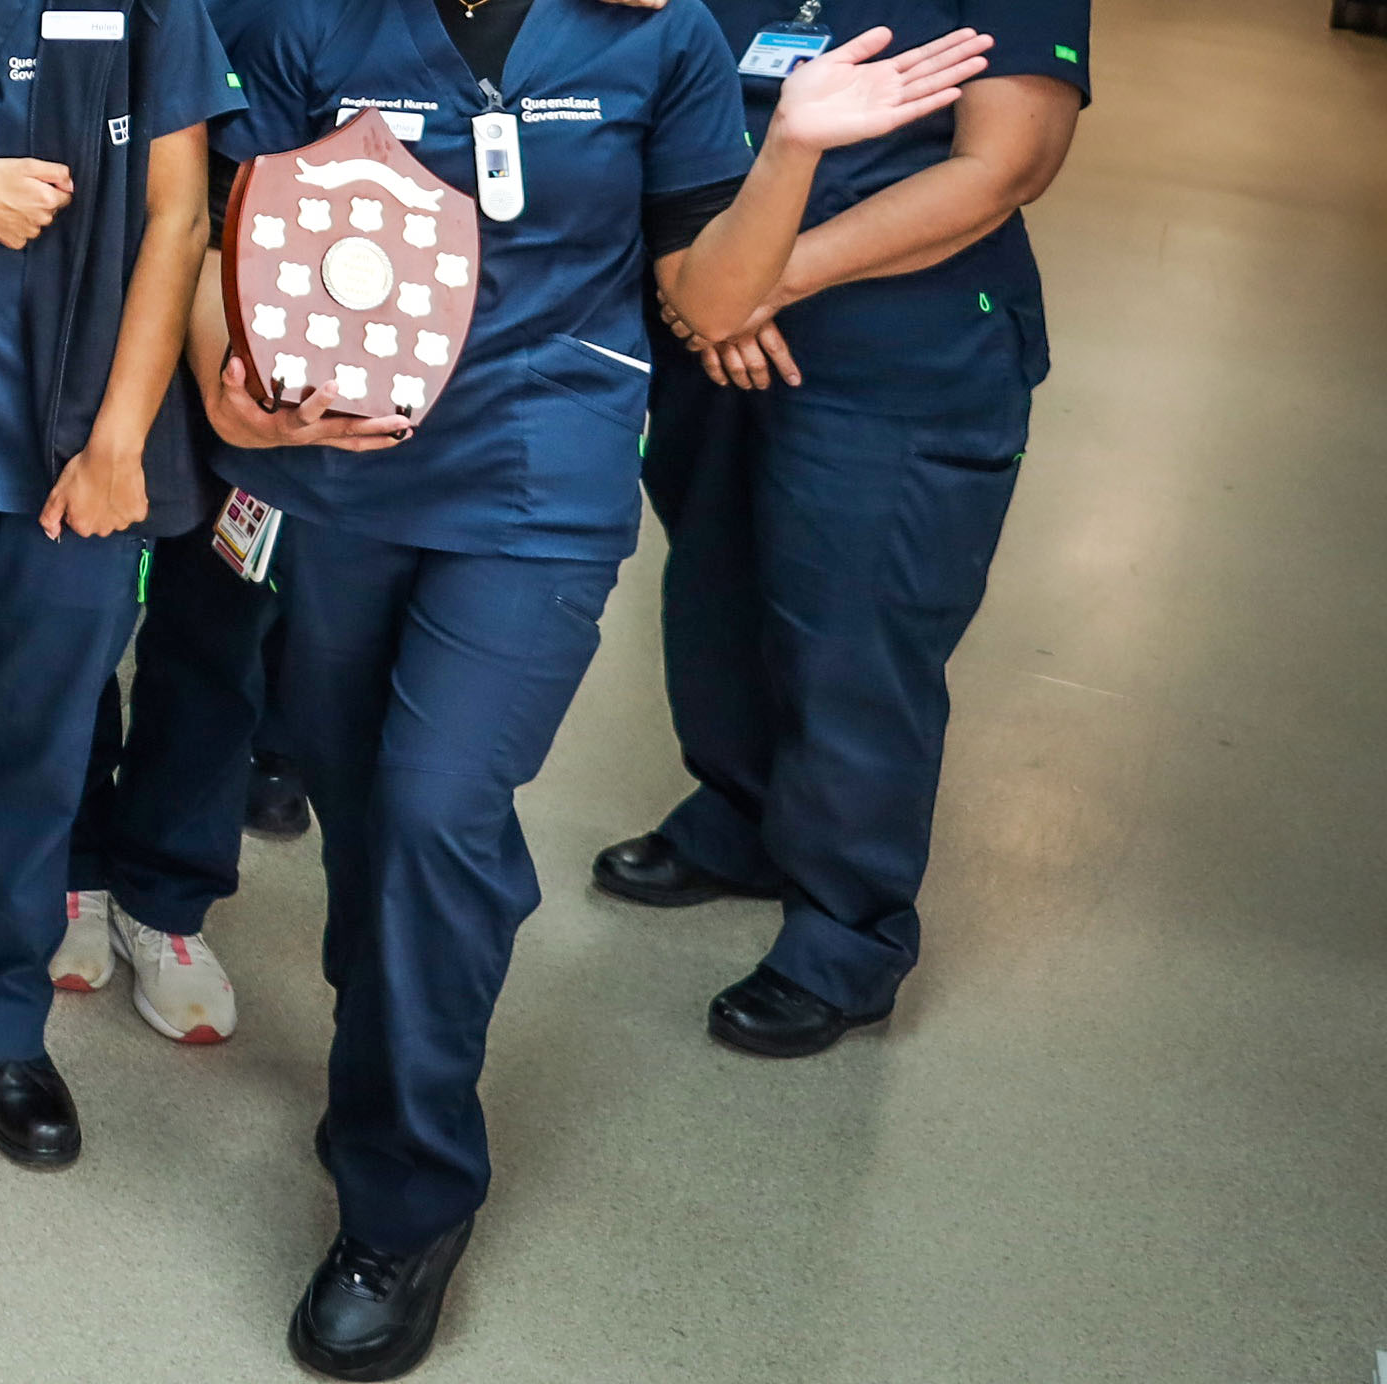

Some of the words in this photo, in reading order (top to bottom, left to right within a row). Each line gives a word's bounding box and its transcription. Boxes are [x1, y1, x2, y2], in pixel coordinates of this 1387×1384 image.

[340, 96, 405, 109] Registered
[406, 98, 438, 111] Nurse
[520, 96, 601, 110] Queensland
[520, 110, 603, 123] Government
